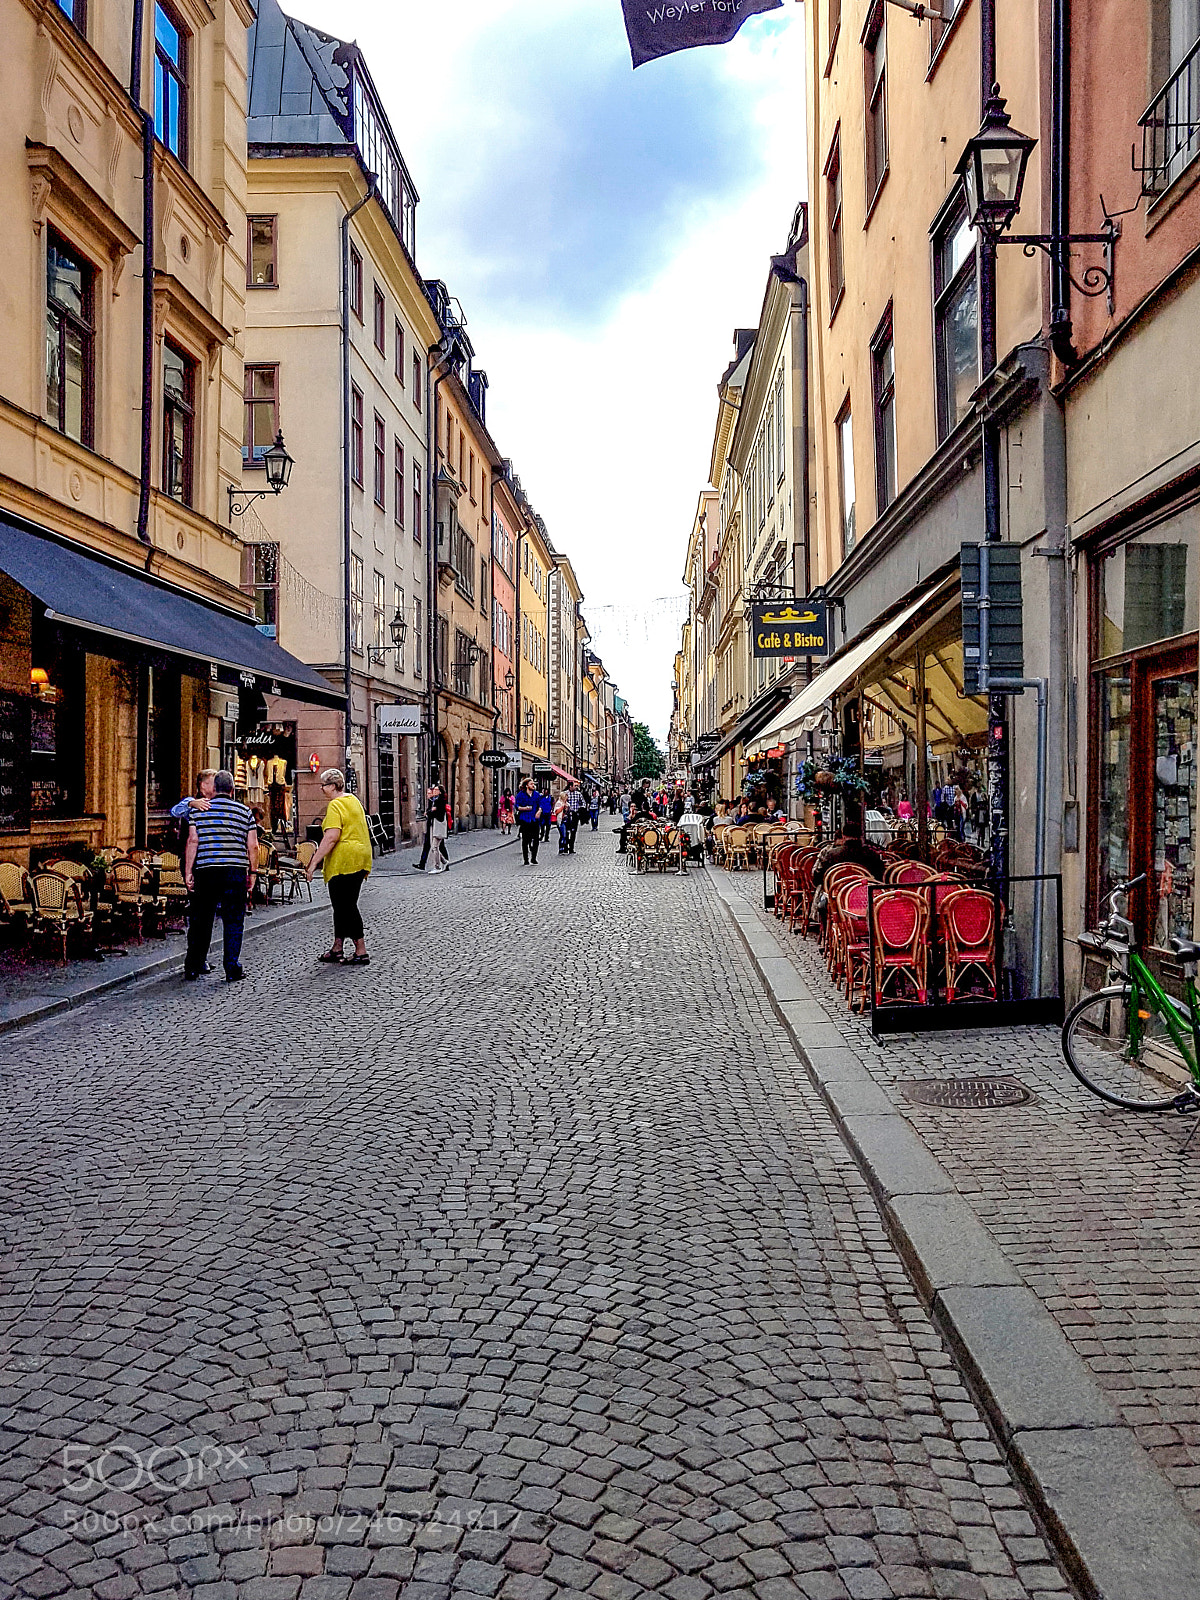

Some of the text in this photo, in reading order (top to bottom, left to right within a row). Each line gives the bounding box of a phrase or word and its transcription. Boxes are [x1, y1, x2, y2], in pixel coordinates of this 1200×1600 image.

[646, 1, 706, 24] Weyler
[783, 632, 792, 648] &
[794, 632, 824, 647] Bistro
